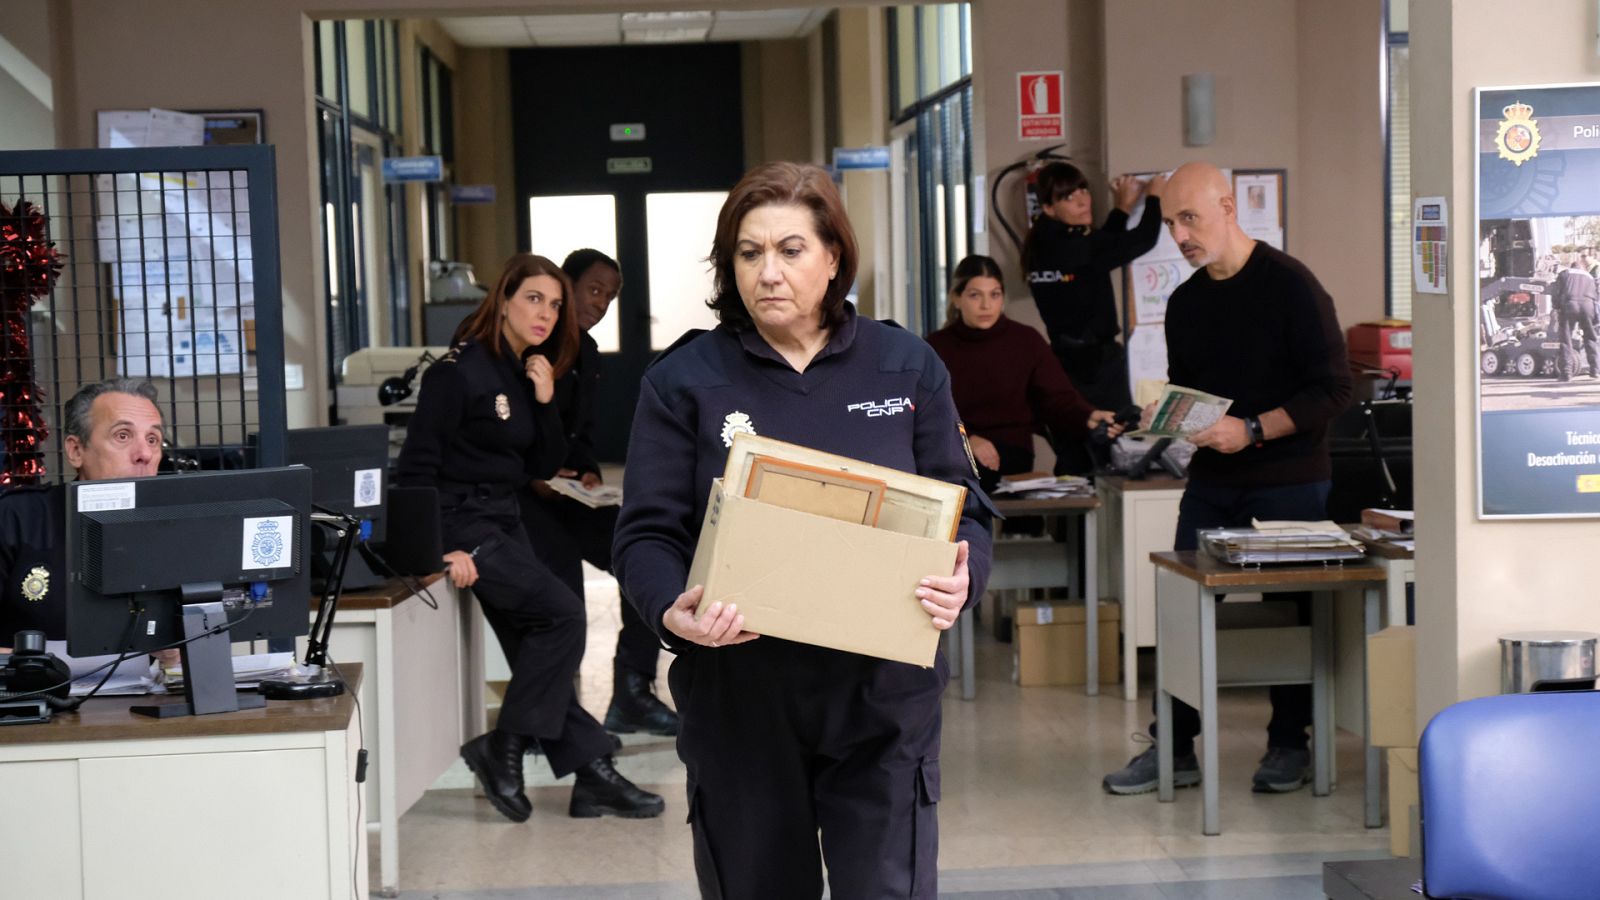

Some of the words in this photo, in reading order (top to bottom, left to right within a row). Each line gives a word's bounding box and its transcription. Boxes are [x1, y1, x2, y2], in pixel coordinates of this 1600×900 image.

[1573, 125, 1599, 138] Poli
[848, 397, 912, 412] POLICIA
[867, 407, 904, 417] CNP
[1527, 450, 1596, 467] Desactivación
